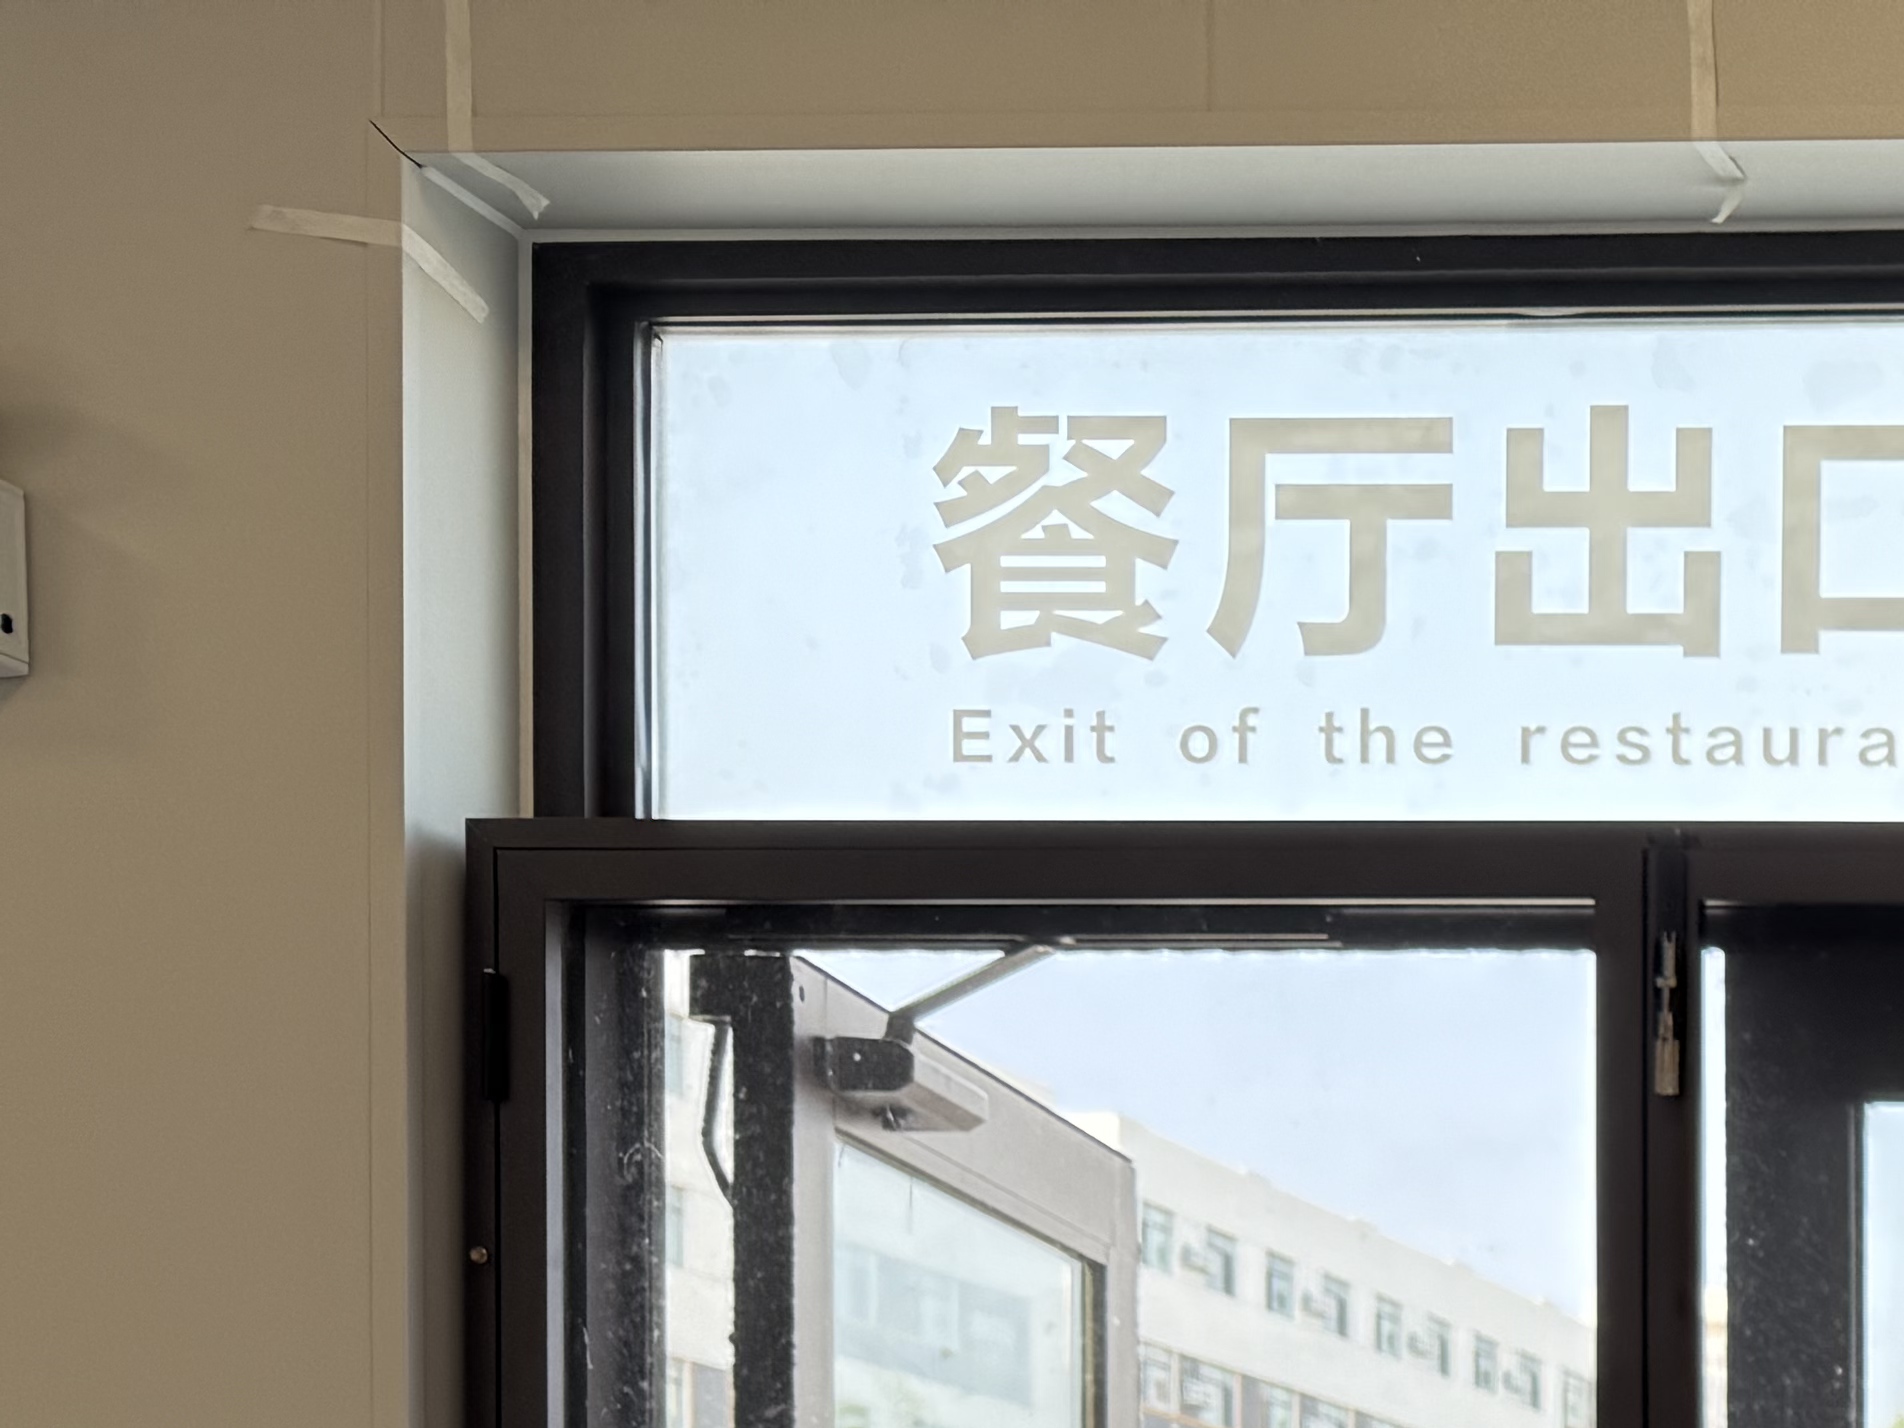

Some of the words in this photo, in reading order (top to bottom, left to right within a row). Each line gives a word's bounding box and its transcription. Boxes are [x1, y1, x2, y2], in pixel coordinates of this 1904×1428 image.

[951, 707, 1117, 765] Exit
[1178, 705, 1262, 766] of
[1316, 706, 1454, 766] the
